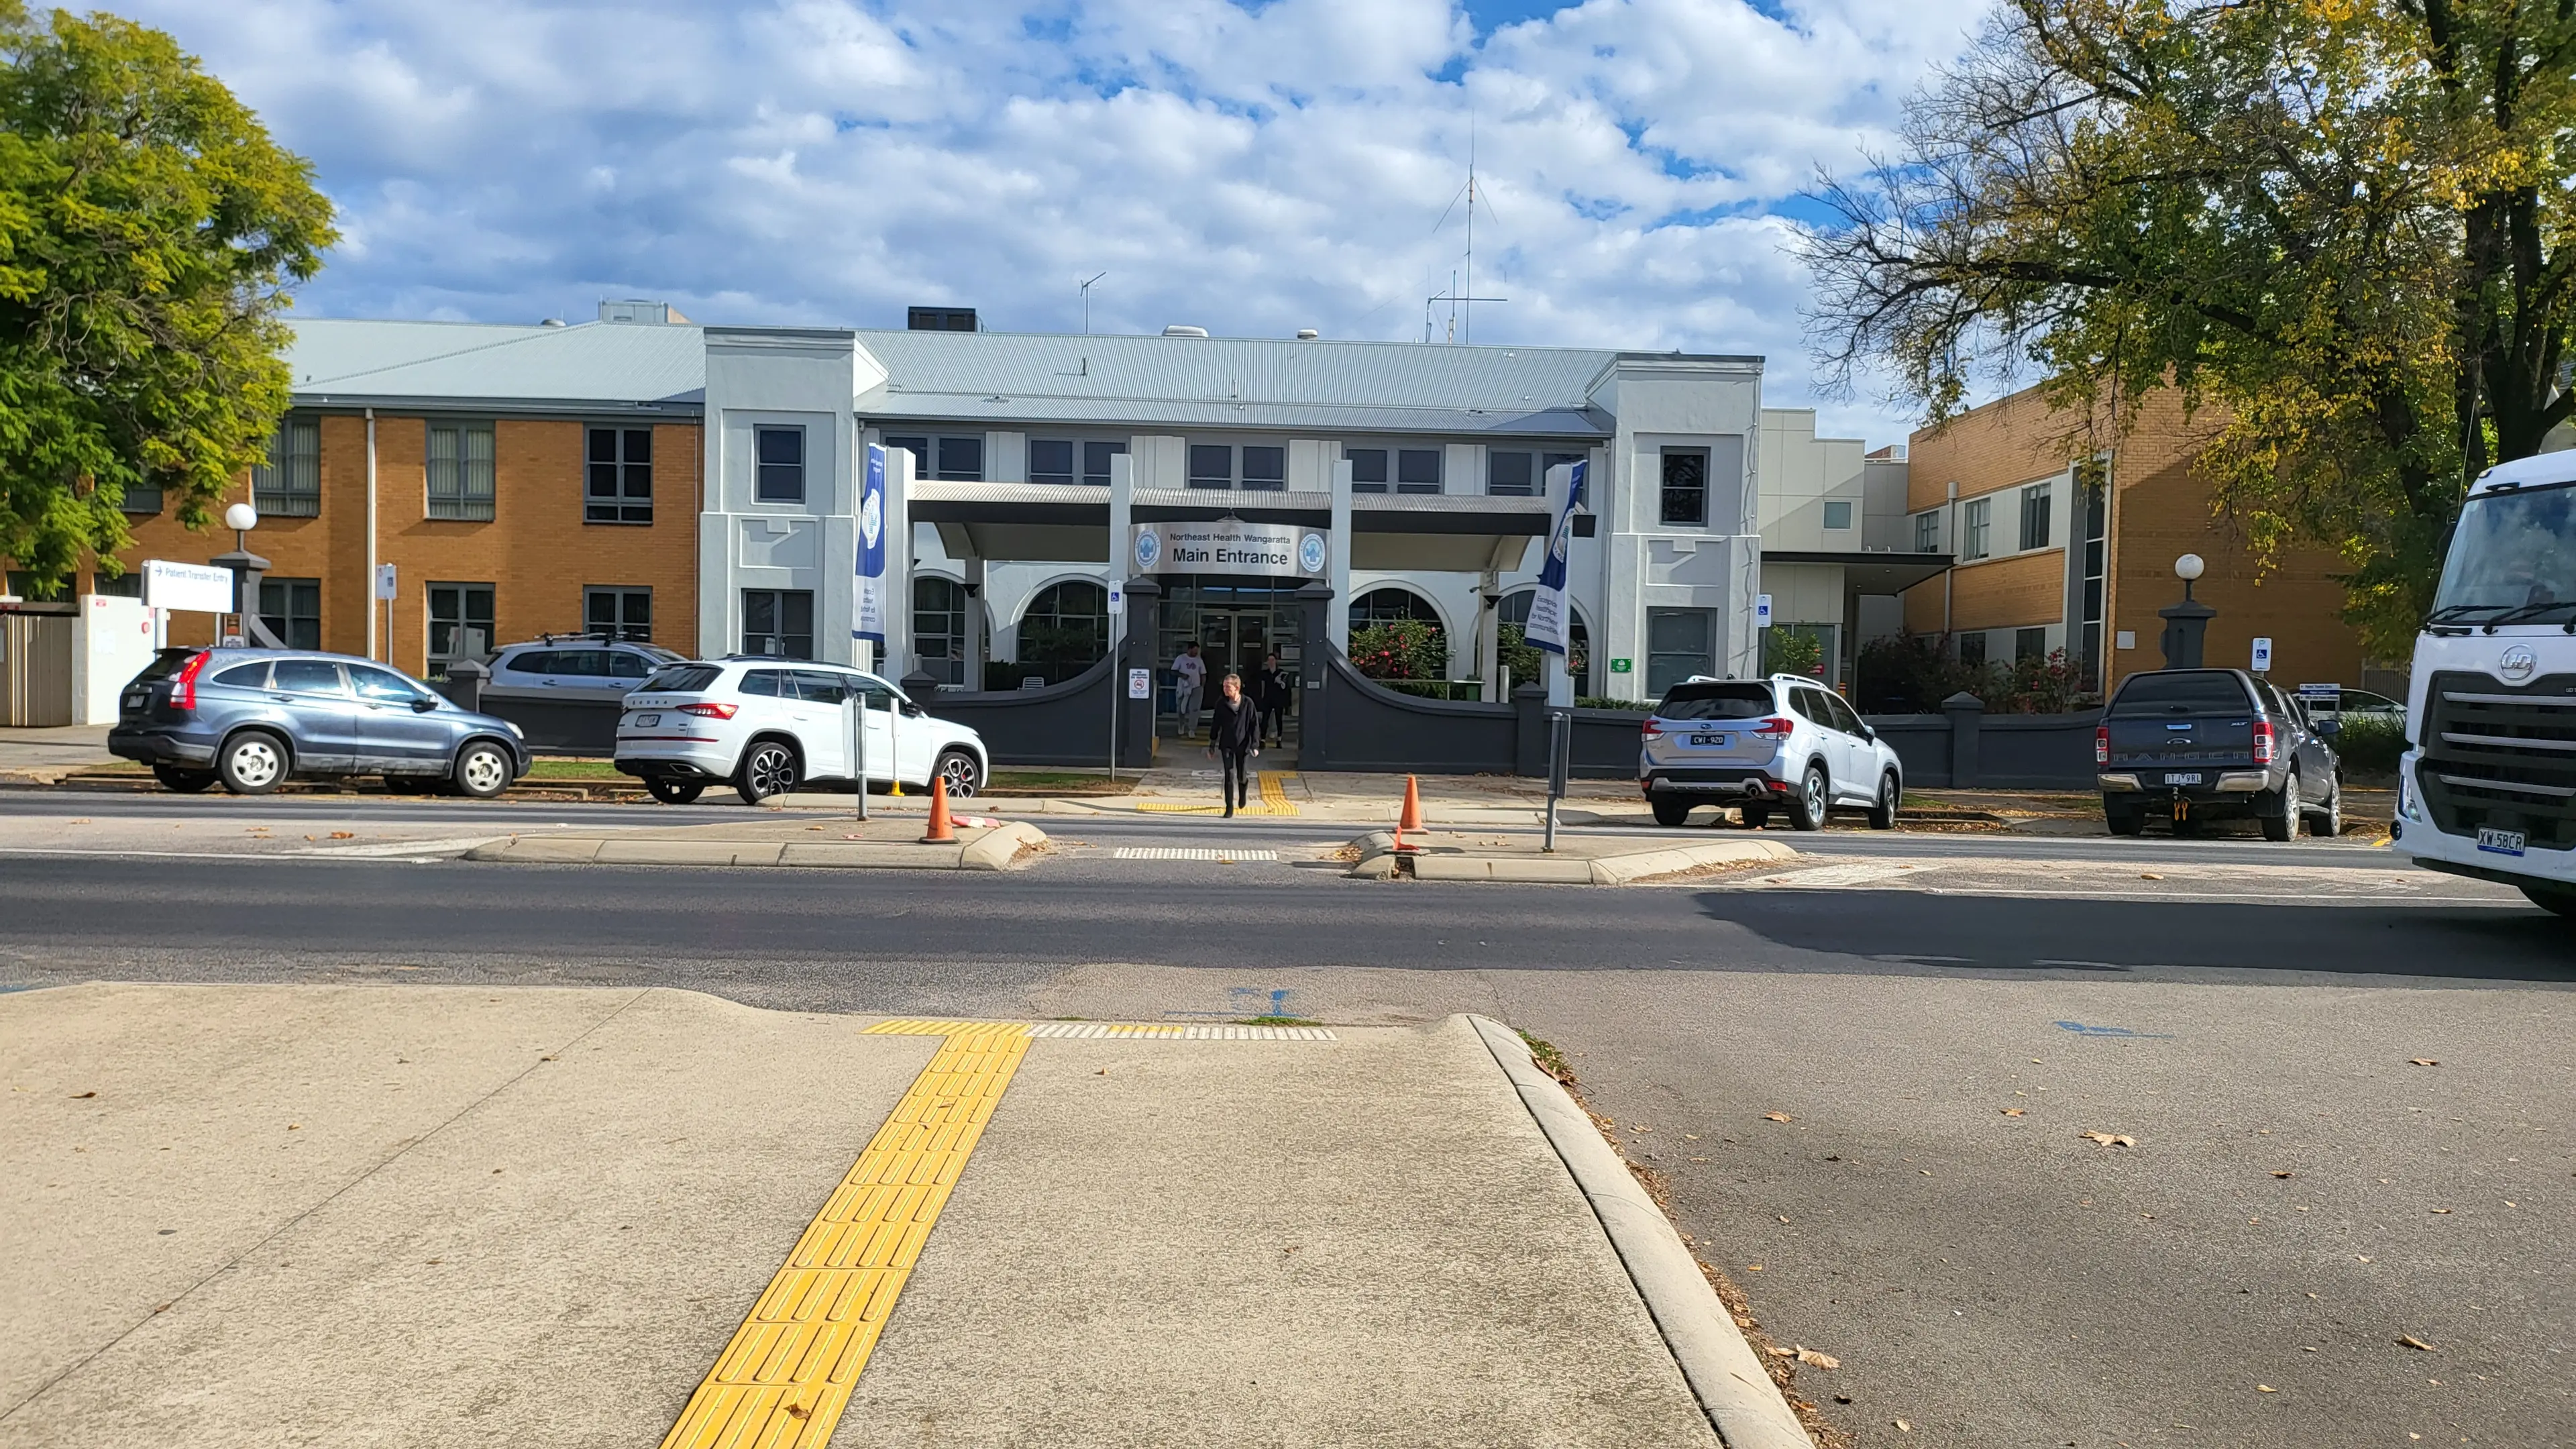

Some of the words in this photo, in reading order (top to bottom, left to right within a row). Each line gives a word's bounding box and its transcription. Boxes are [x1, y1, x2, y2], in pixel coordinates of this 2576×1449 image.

[1170, 533, 1210, 541] Northeast
[1213, 533, 1241, 542] Health
[1244, 534, 1291, 544] Wangaratta
[1173, 548, 1209, 562] Main
[1216, 549, 1288, 565] Entrance
[166, 568, 186, 579] Patient
[188, 570, 212, 582] Transfer
[213, 572, 228, 585] Entry
[2113, 751, 2249, 761] RANGER
